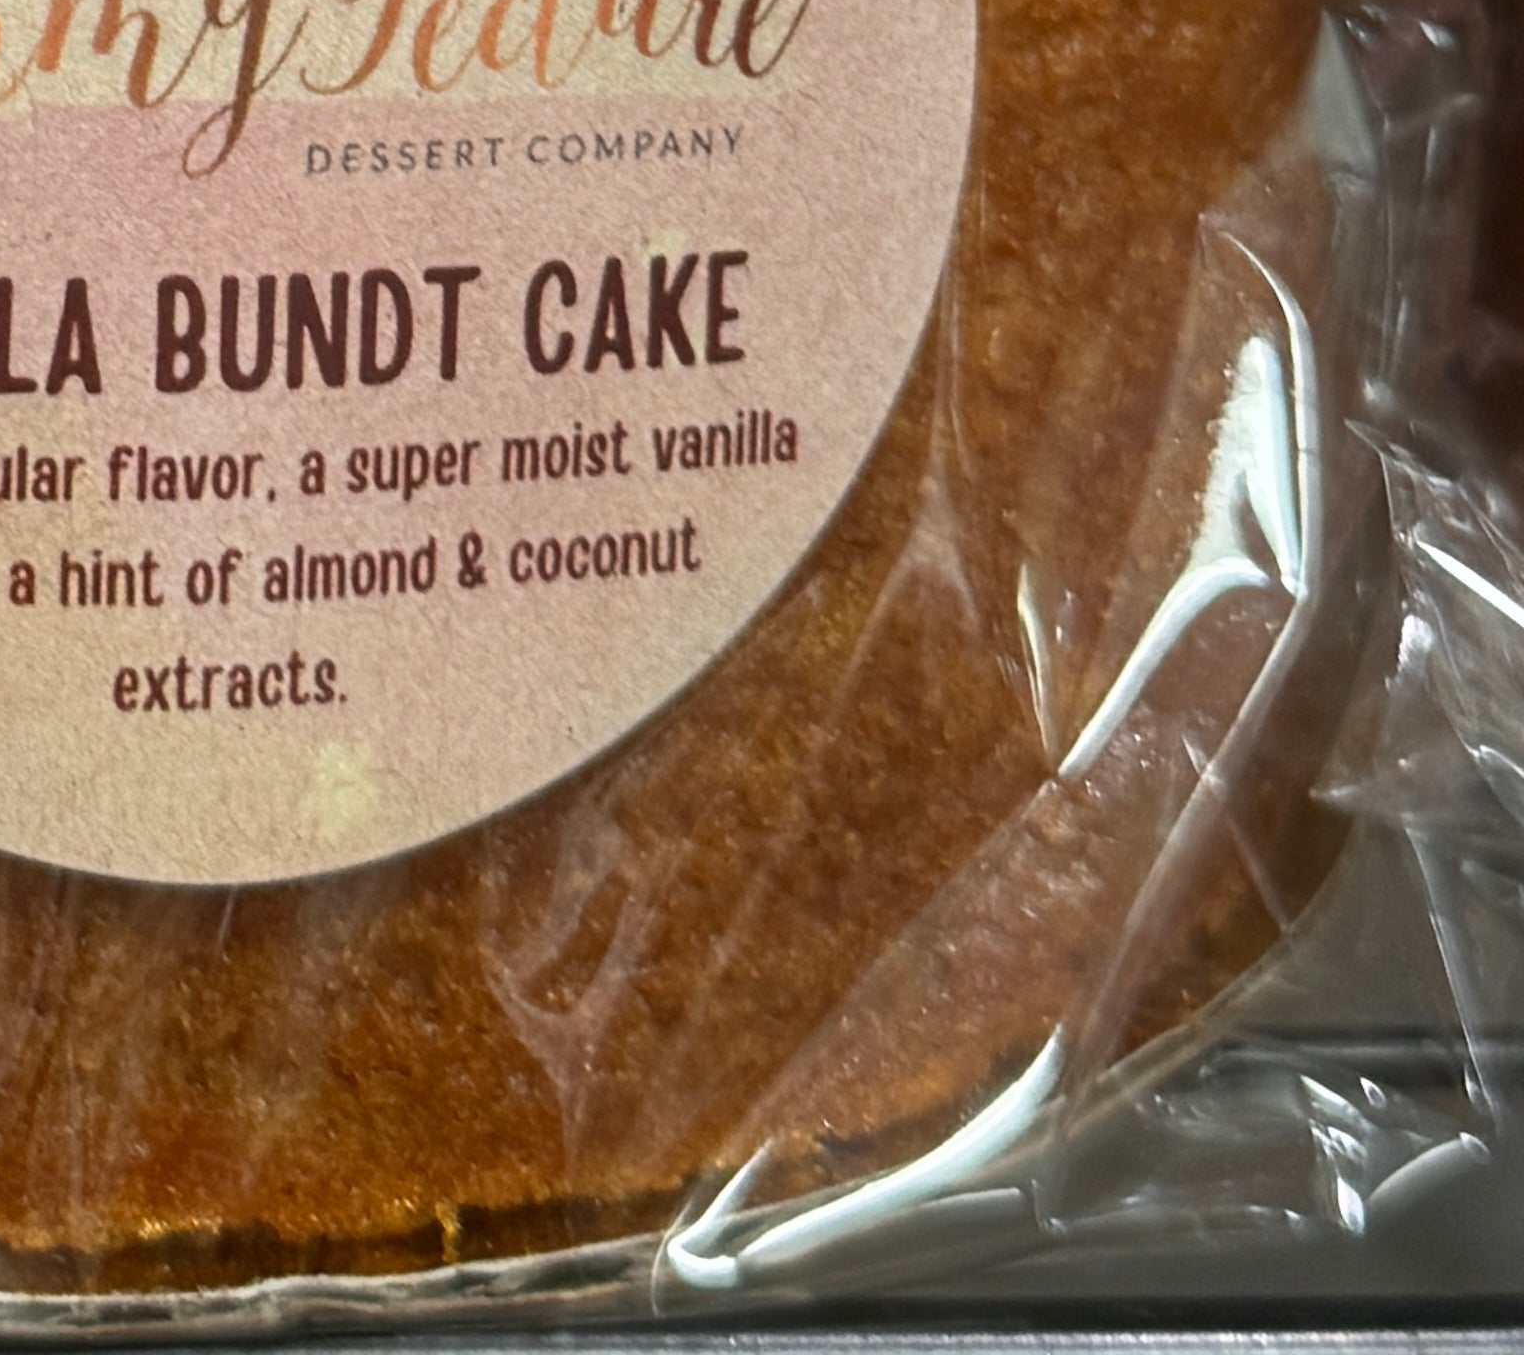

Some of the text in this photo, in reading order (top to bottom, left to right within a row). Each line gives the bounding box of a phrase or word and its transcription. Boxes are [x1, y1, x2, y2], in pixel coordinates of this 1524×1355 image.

[305, 126, 745, 175] DESSERT COMPANY
[155, 265, 482, 393] BUNDT
[523, 250, 750, 375] CAKE
[299, 449, 327, 496] a
[346, 440, 482, 502] super
[501, 421, 632, 481] moist
[652, 409, 799, 473] vanilla
[9, 558, 37, 606] a
[59, 549, 164, 606] hint
[185, 549, 242, 607] of
[262, 536, 438, 604] almond
[457, 532, 486, 590] &
[509, 518, 701, 584] coconut
[112, 650, 348, 713] extracts.
